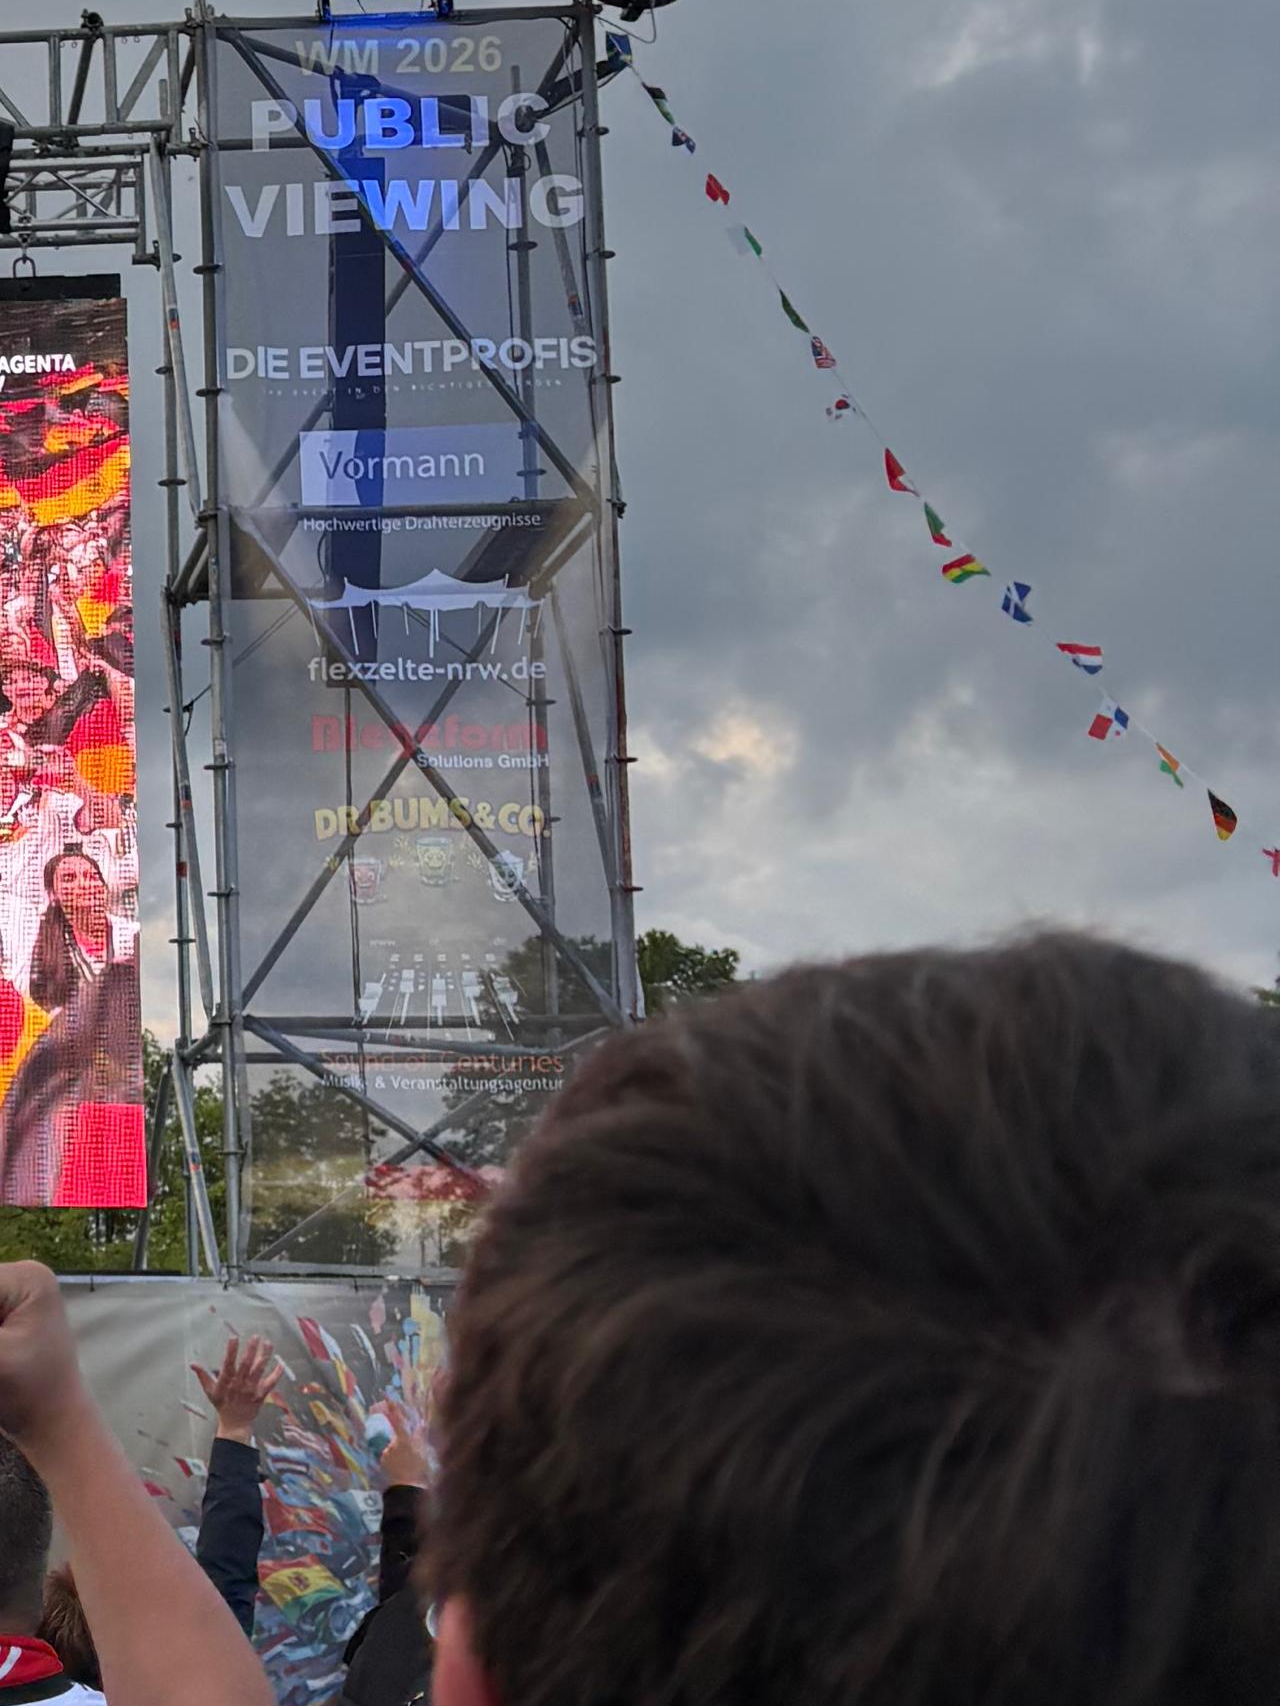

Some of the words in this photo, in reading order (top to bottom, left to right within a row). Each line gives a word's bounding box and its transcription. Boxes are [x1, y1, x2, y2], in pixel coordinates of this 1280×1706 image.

[295, 40, 378, 76] WM
[396, 35, 502, 73] 2026
[251, 93, 551, 152] PUBLIC
[224, 174, 585, 237] VIEWING
[226, 345, 290, 380] DIE
[300, 335, 598, 380] EVENTPROFIS
[320, 451, 485, 480] Vormann
[303, 516, 402, 534] Hochwertige
[405, 512, 541, 531] Drahterzeugnisse
[307, 656, 547, 682] flexzelte-nrw.de
[417, 754, 493, 769] Solutions
[498, 754, 550, 768] GmbH
[392, 1076, 565, 1093] Veranstaltungsagentur
